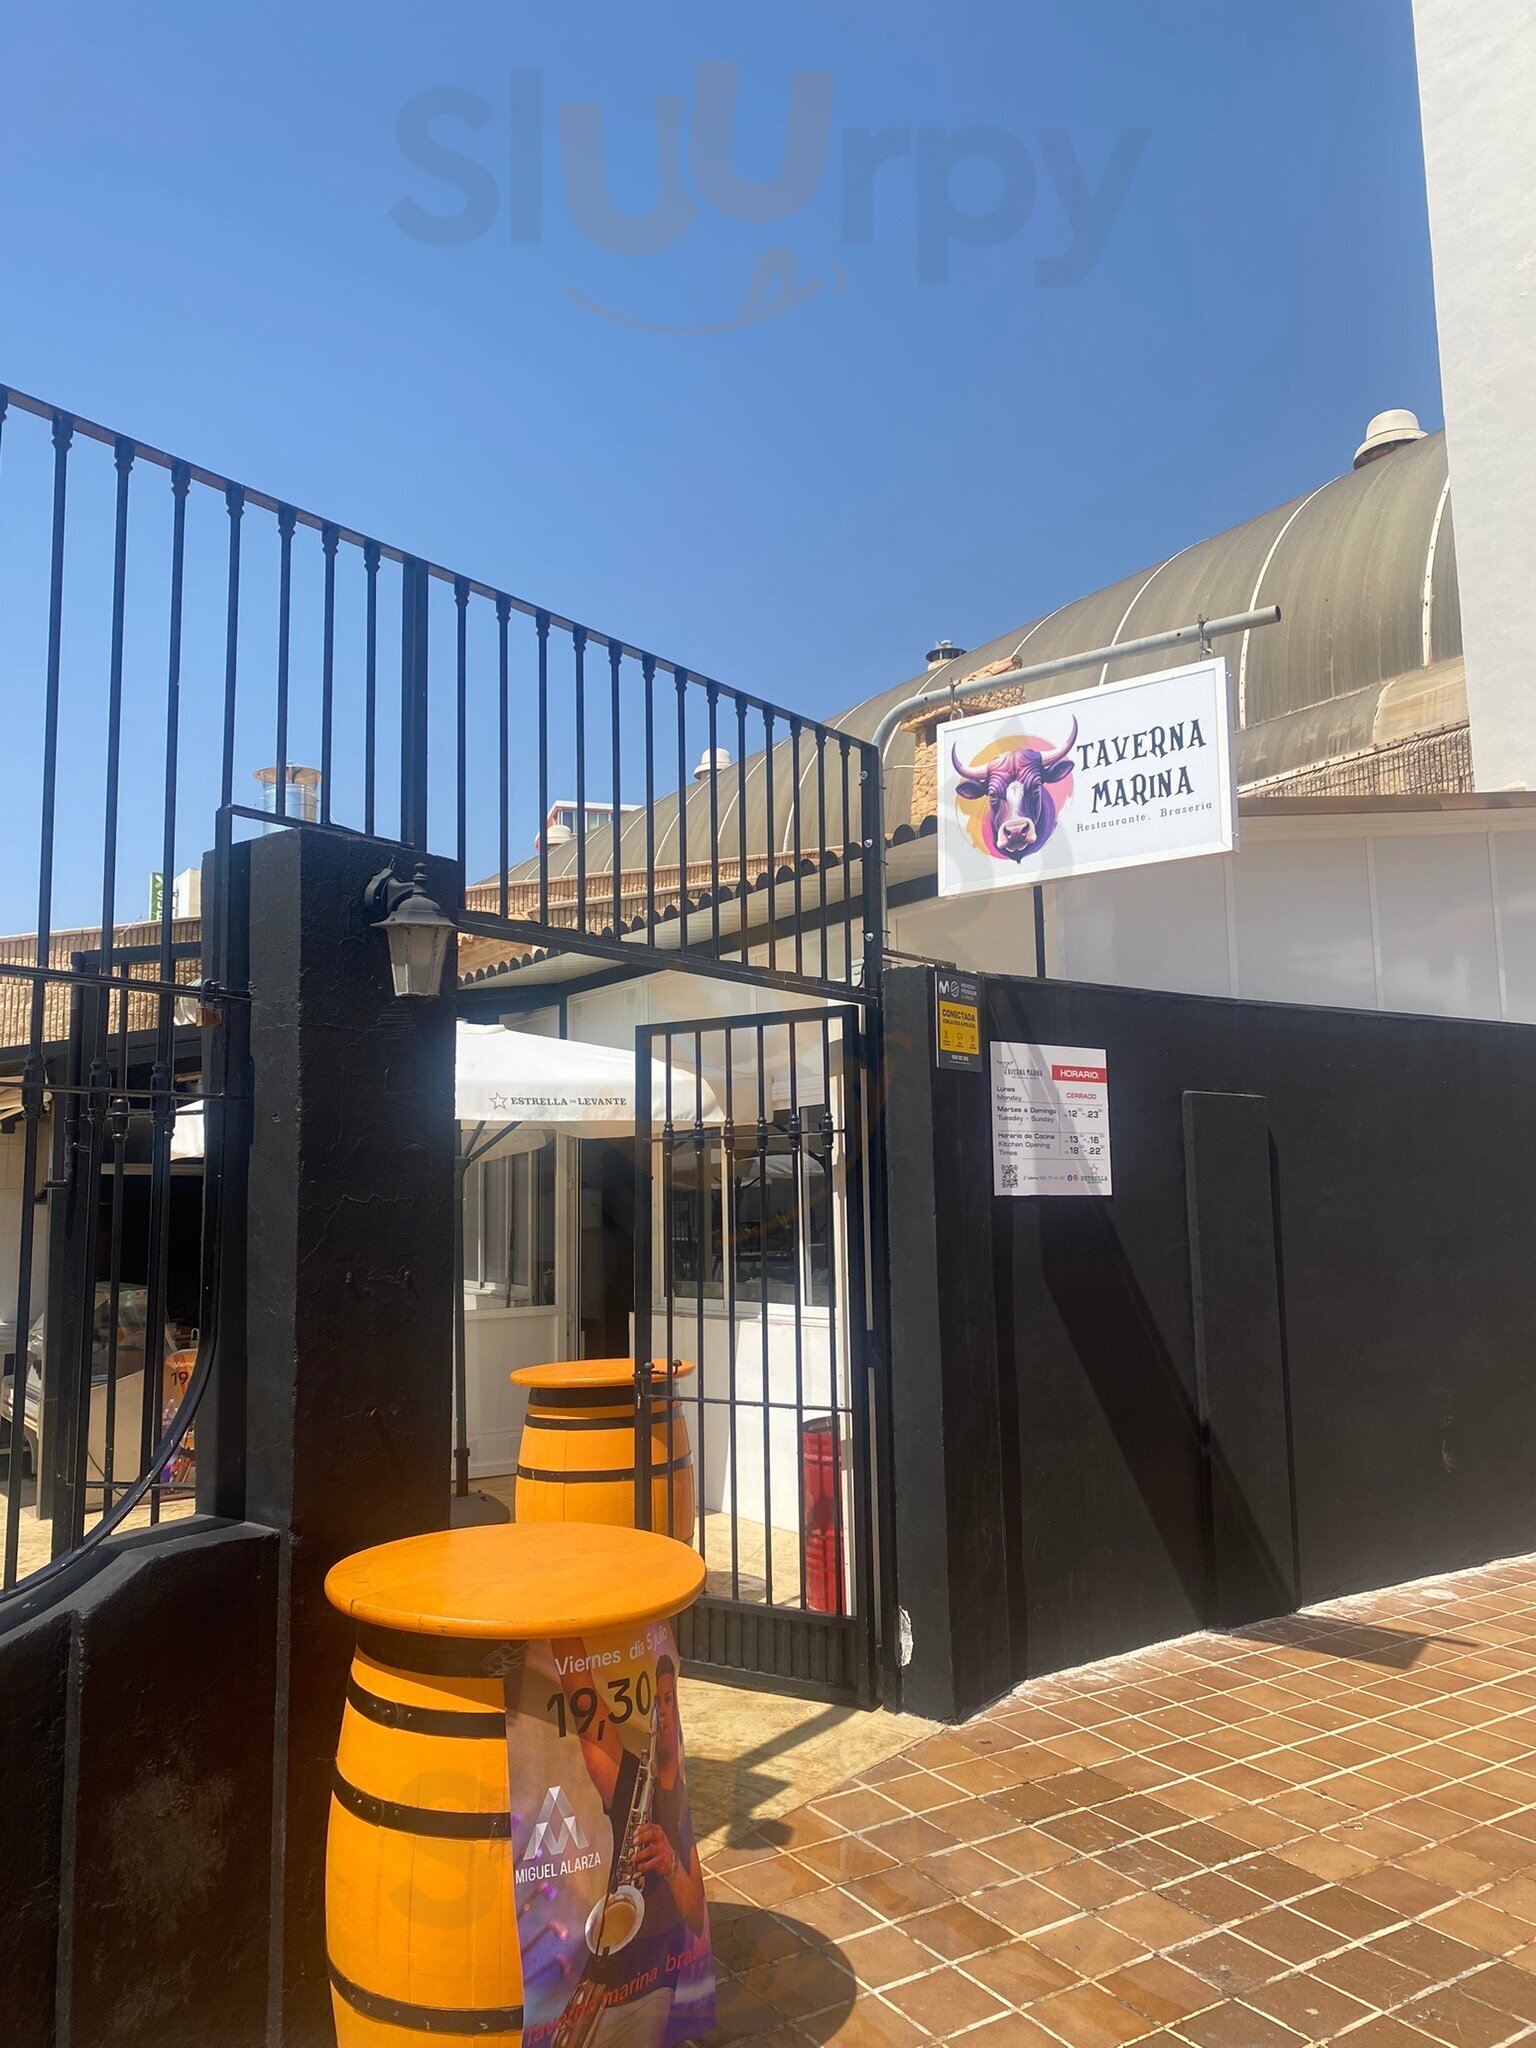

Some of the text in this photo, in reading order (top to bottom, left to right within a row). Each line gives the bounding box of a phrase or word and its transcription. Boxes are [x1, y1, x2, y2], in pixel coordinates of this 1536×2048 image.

[1076, 718, 1207, 772] TAVERNA
[1091, 765, 1195, 814] MARINA
[996, 1094, 1022, 1102] Monday
[1066, 1092, 1097, 1100] CERRADO
[510, 1097, 568, 1106] ESTRELLA
[577, 1097, 628, 1106] LEVANTE
[996, 1105, 1022, 1113] Martes
[1030, 1106, 1057, 1116] Domingo
[1068, 1109, 1078, 1118] 12
[1087, 1110, 1099, 1119] 23
[997, 1114, 1023, 1122] Tuesday
[1030, 1115, 1055, 1123] Sunday
[1069, 1135, 1079, 1144] 13
[1089, 1136, 1100, 1144] 16
[1025, 1141, 1050, 1150] Opening
[1069, 1146, 1080, 1155] 18
[1089, 1147, 1101, 1155] 22
[554, 1649, 621, 1676] Viernes
[646, 1632, 653, 1650] 5
[652, 1625, 668, 1652] julio
[547, 1670, 652, 1741] 19,30
[515, 1851, 601, 1885] MIGUEL ALARZA
[601, 1966, 659, 2007] marina
